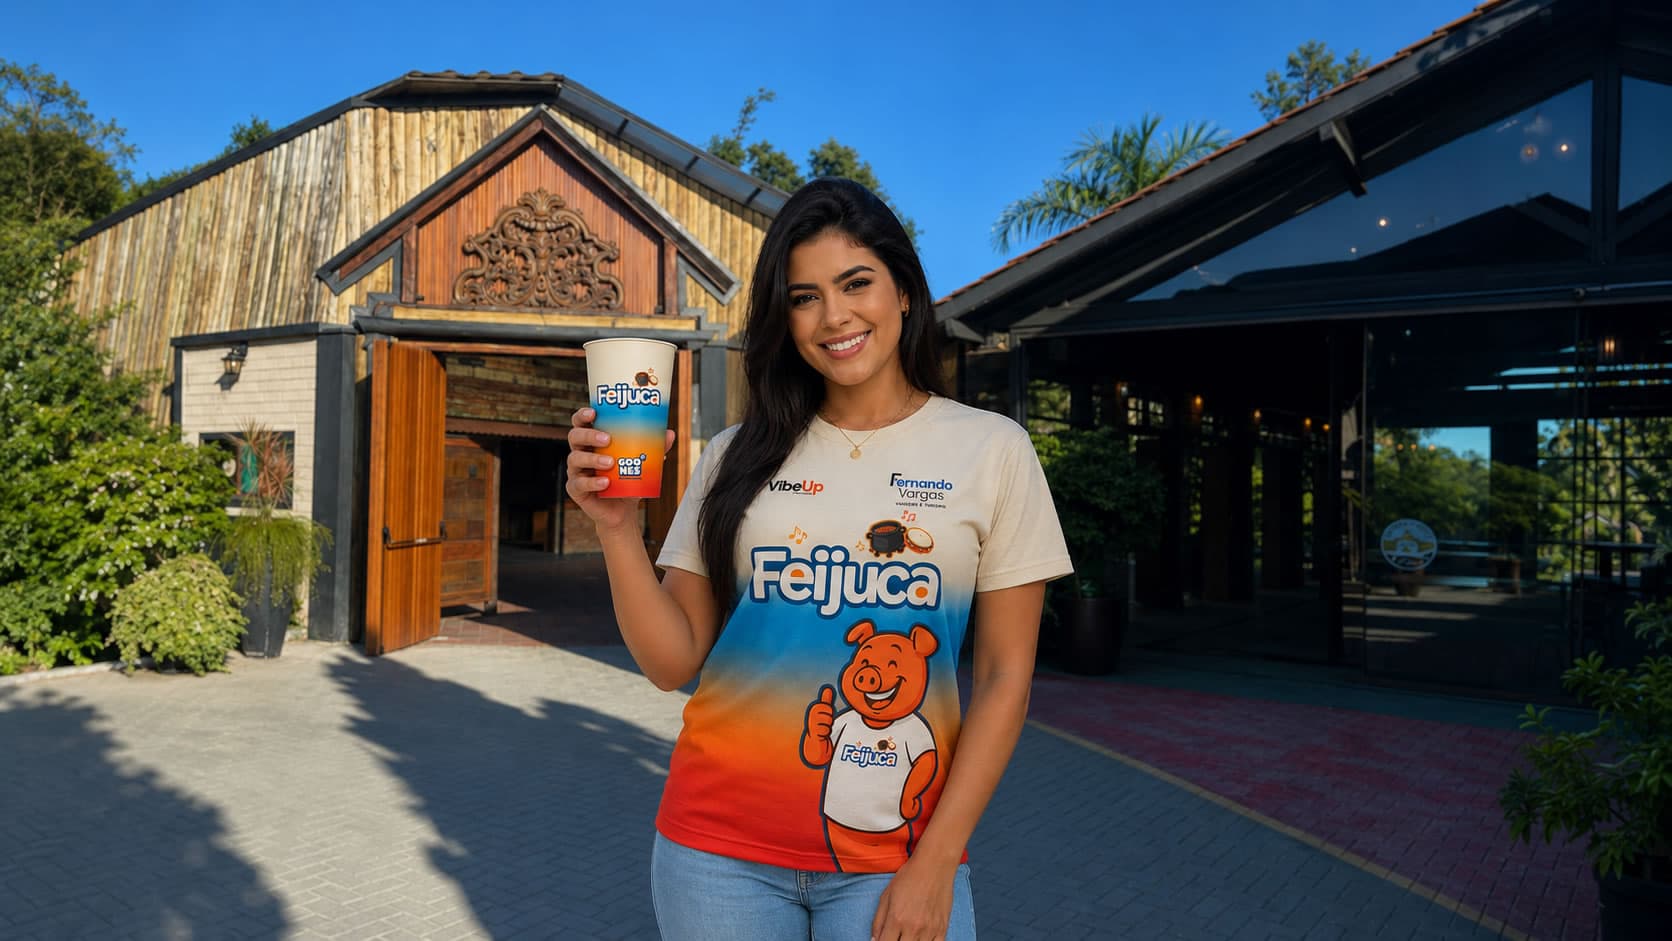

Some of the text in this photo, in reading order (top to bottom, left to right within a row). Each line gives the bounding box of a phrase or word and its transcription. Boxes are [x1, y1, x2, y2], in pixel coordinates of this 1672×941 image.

[597, 383, 661, 409] Feijuca
[769, 480, 824, 496] VibeUp
[890, 472, 953, 491] Fernando
[898, 488, 944, 502] Vargas
[752, 546, 941, 618] Feijuca
[841, 744, 897, 768] Feijuca
